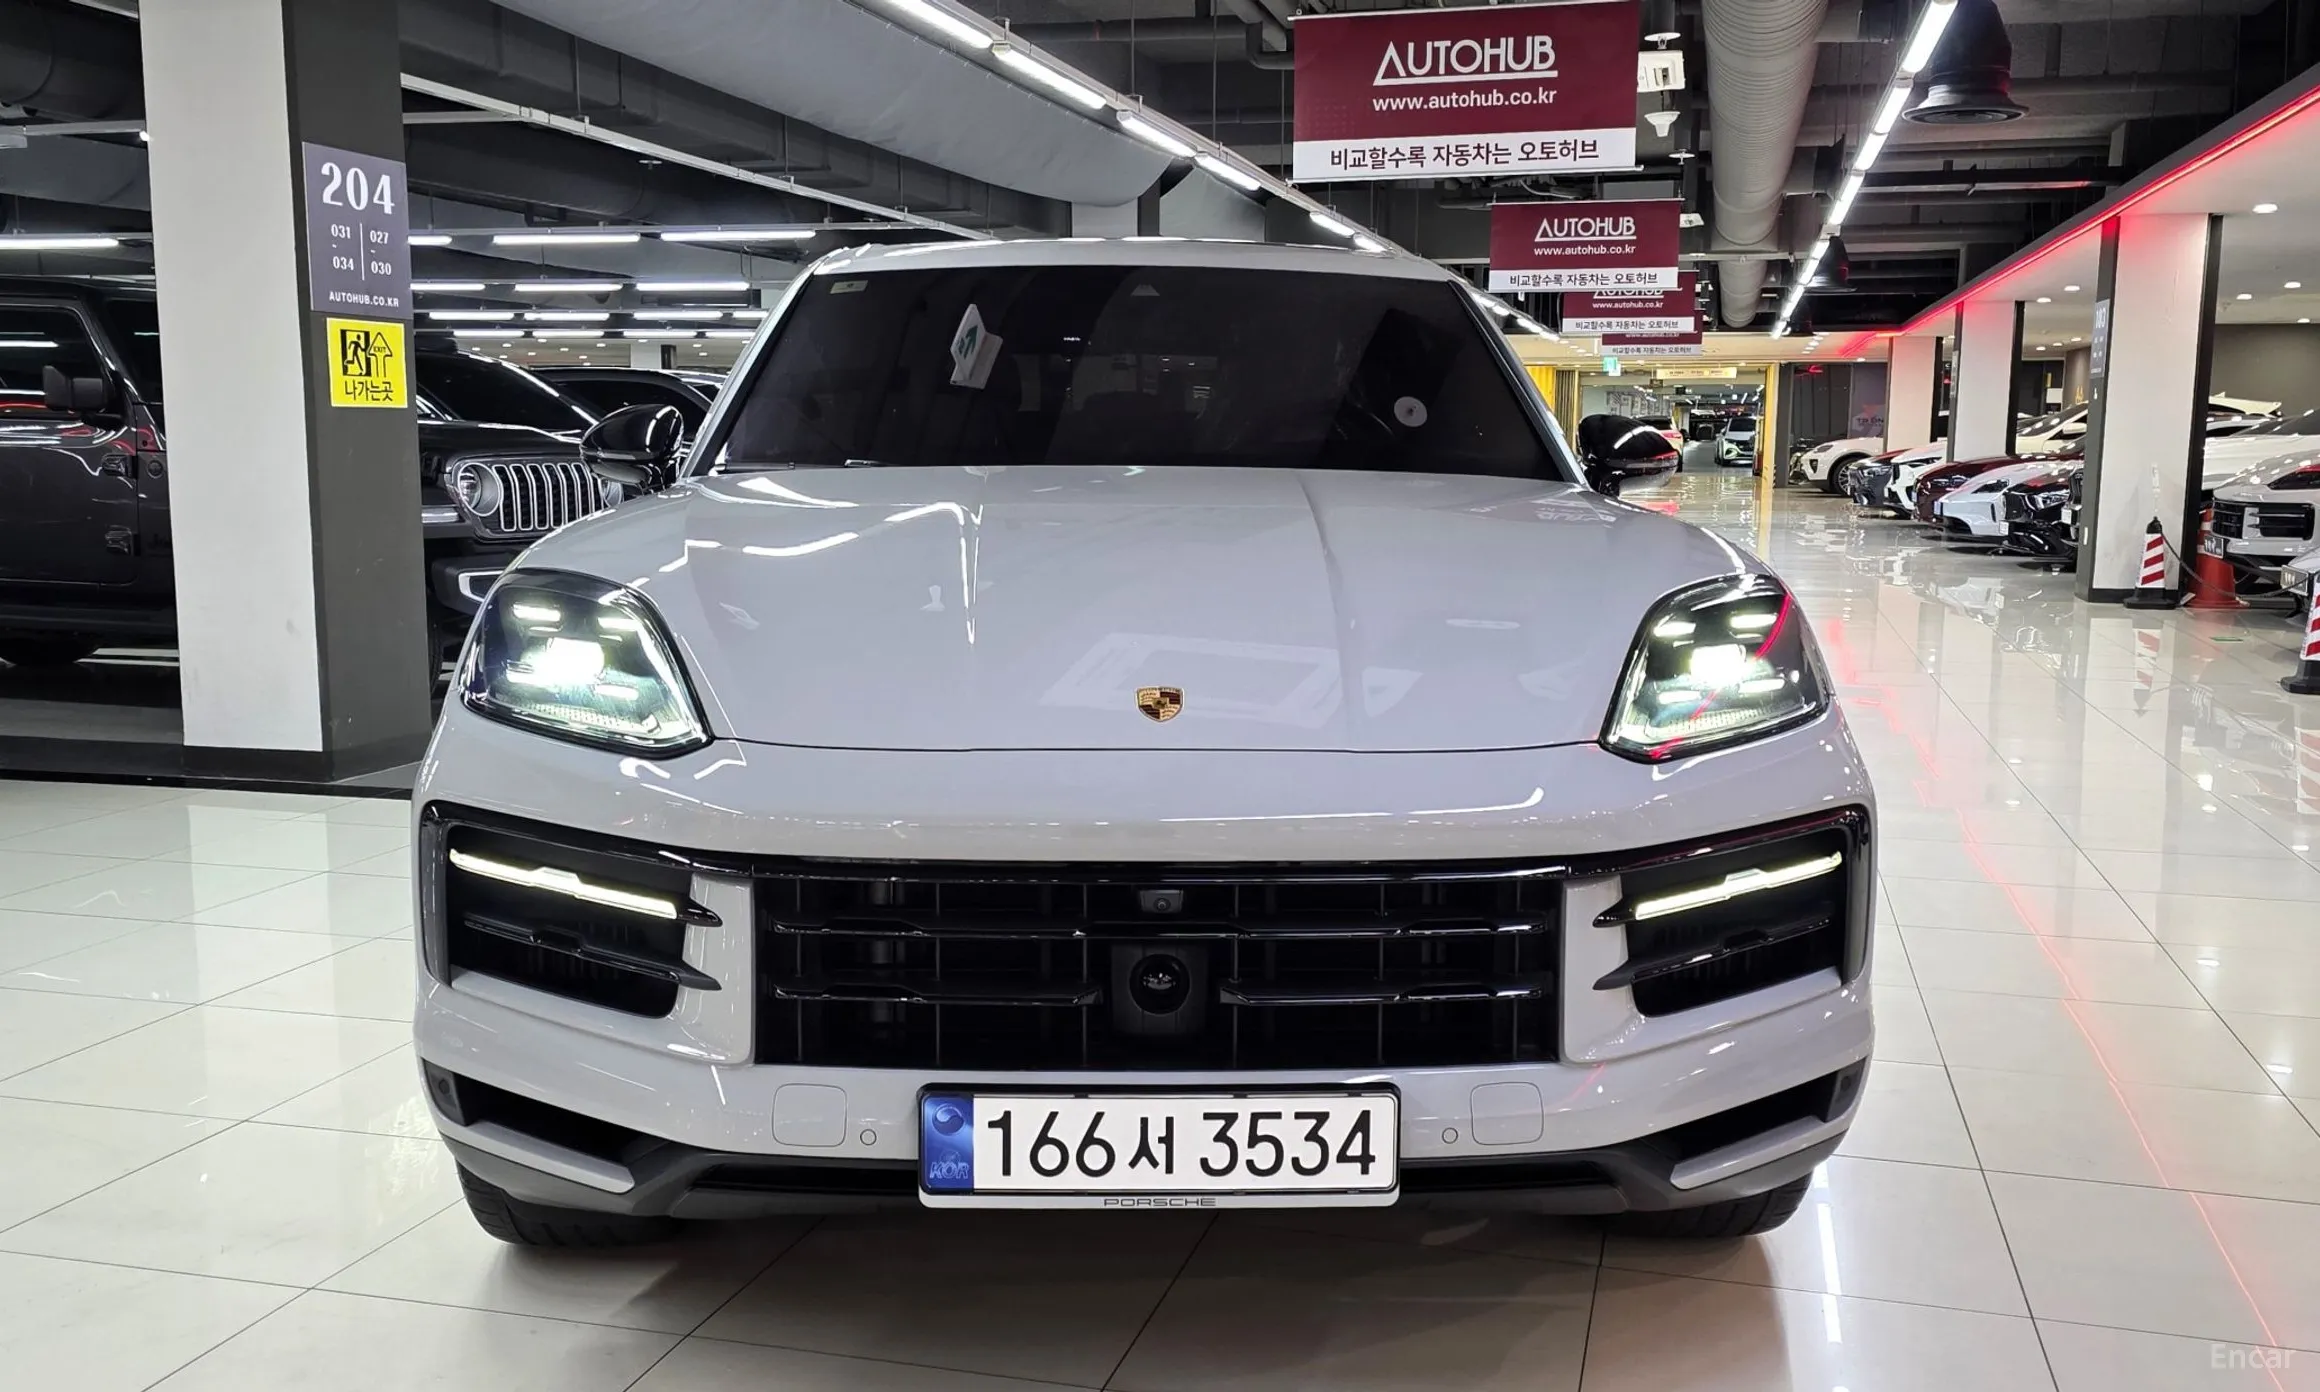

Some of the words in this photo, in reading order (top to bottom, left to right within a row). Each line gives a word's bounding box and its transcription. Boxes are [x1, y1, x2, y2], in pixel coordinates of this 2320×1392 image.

[1373, 36, 1558, 86] AUTOHUB
[1373, 87, 1557, 112] www.autohub.co.kr
[1330, 146, 1427, 171] 비교할수록
[1432, 142, 1512, 167] 자동차는
[1517, 139, 1600, 162] 오토허브
[321, 162, 396, 215] 204
[330, 223, 351, 239] 031
[369, 230, 389, 245] 027
[1534, 216, 1637, 242] AUTOHUB
[1534, 244, 1637, 256] www.autohub.co.kr
[332, 255, 355, 271] 034
[370, 260, 392, 276] 030
[1509, 273, 1564, 287] 비교할수록
[1566, 273, 1611, 287] 자동차는
[1613, 272, 1658, 285] 오토허브
[329, 290, 400, 308] AUTOHUB.CO.KR
[1592, 301, 1664, 309] www.autohub.co.kr
[344, 379, 394, 402] 나가는곳
[987, 1110, 1175, 1178] 166서
[1199, 1109, 1376, 1178] 3534
[929, 1161, 970, 1179] KOR
[1103, 1197, 1216, 1207] PORSCHE
